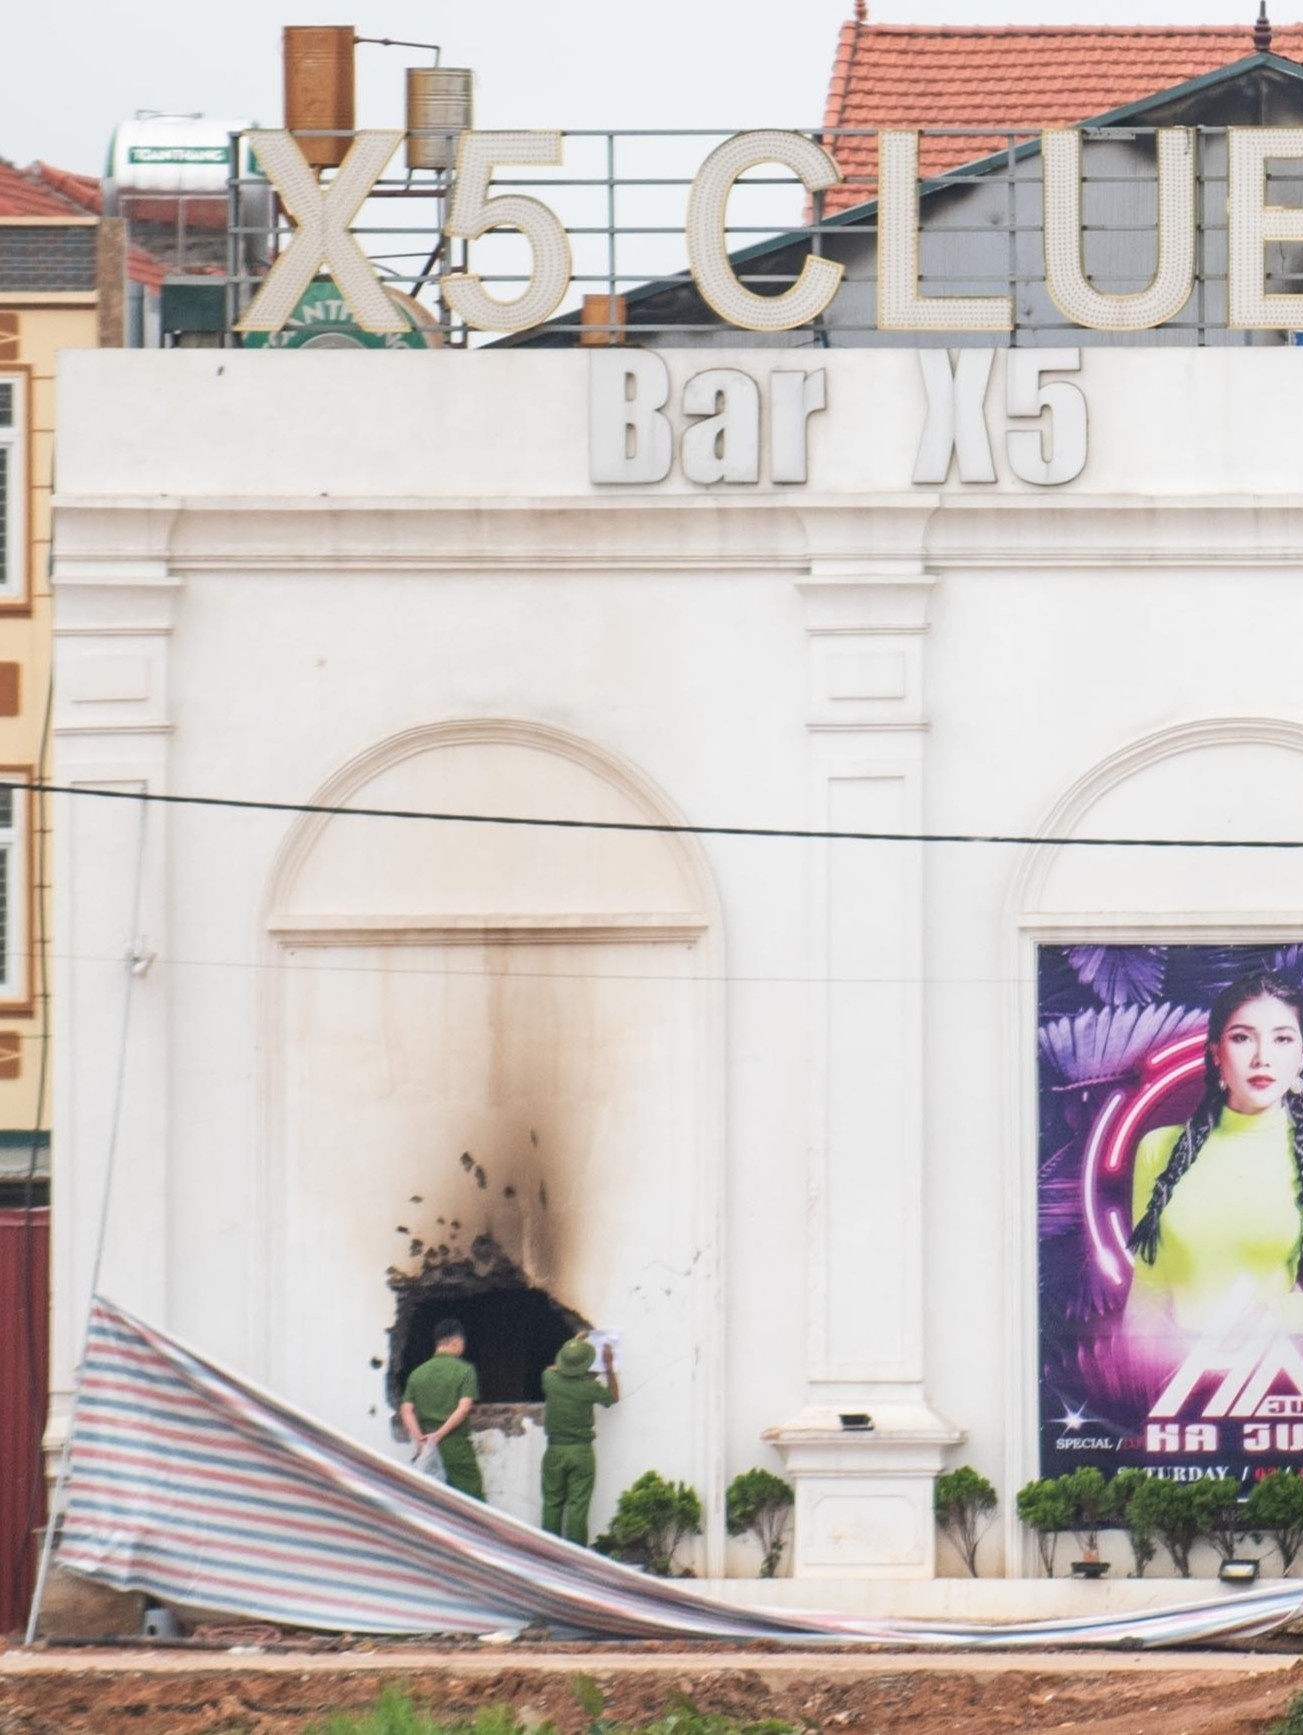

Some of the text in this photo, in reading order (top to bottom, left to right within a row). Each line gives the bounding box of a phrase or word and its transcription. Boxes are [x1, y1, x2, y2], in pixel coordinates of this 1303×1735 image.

[232, 128, 573, 333] X5
[588, 348, 1090, 487] Bar X5
[1056, 1438, 1113, 1450] SPECIAL
[1146, 1423, 1218, 1452] HA
[1117, 1466, 1230, 1482] STURDAY
